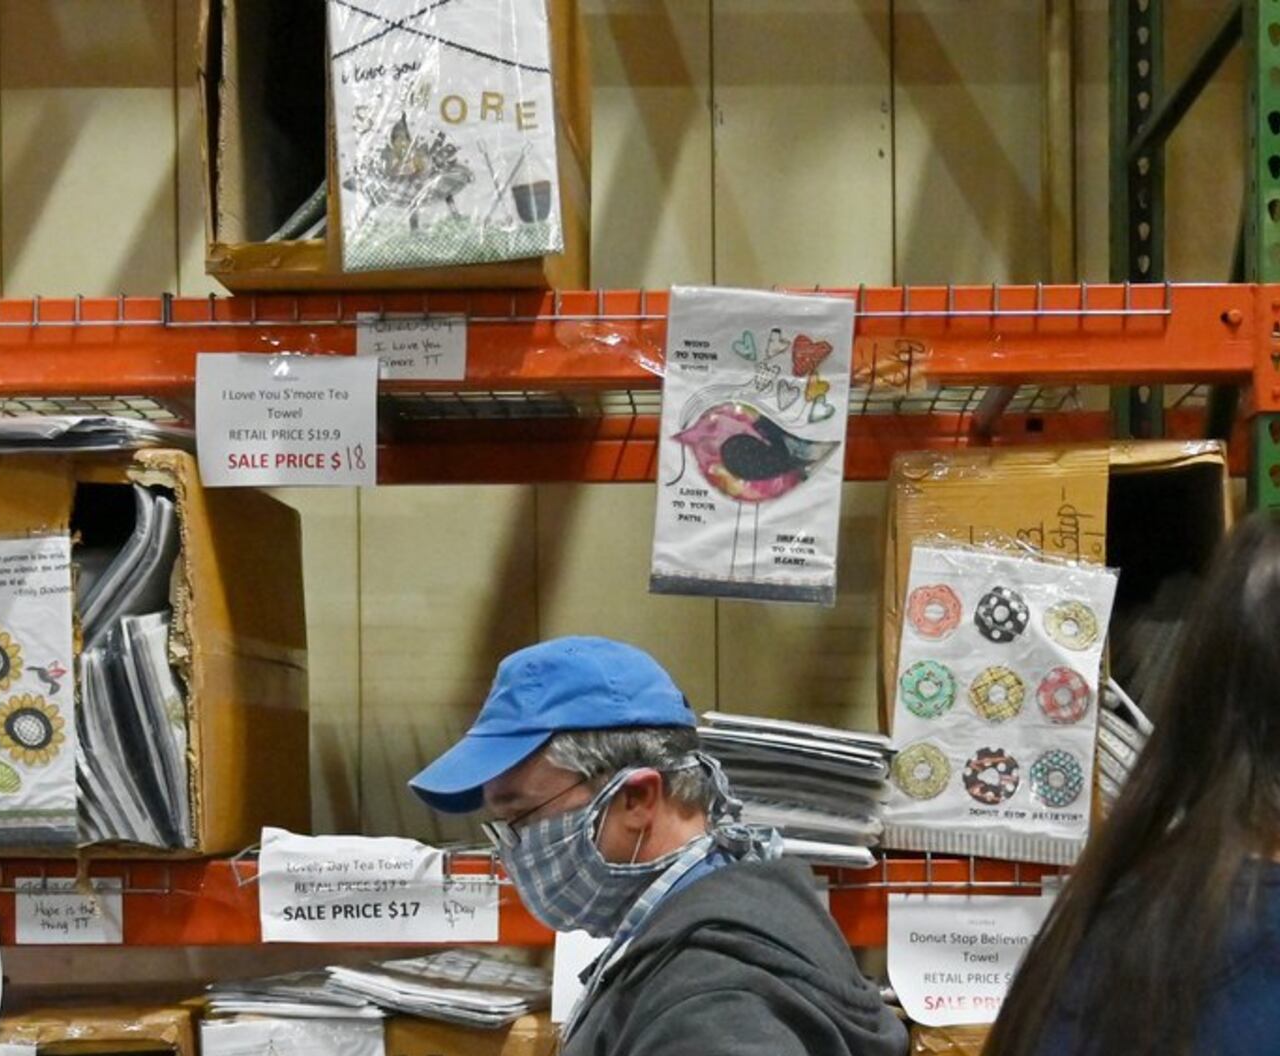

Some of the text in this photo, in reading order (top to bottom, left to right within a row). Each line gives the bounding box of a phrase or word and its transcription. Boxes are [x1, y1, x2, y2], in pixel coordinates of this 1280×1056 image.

[229, 390, 256, 400] Love
[258, 390, 281, 400] You
[283, 389, 324, 401] S'more
[328, 389, 349, 400] Tea
[267, 407, 303, 419] Towel
[229, 429, 268, 440] RETAIL
[271, 429, 304, 440] PRICE
[228, 452, 325, 469] SALE PRICE
[327, 860, 349, 872] Day
[353, 860, 374, 871] Tea
[378, 858, 414, 870] Towel
[294, 882, 333, 893] RETAIL
[283, 902, 421, 921] SALE PRICE $17
[909, 931, 947, 944] Donut
[950, 932, 978, 945] Stop
[963, 952, 999, 963] Towel
[924, 972, 964, 984] RETAIL
[967, 972, 1000, 984] PRICE
[924, 996, 968, 1010] SALE
